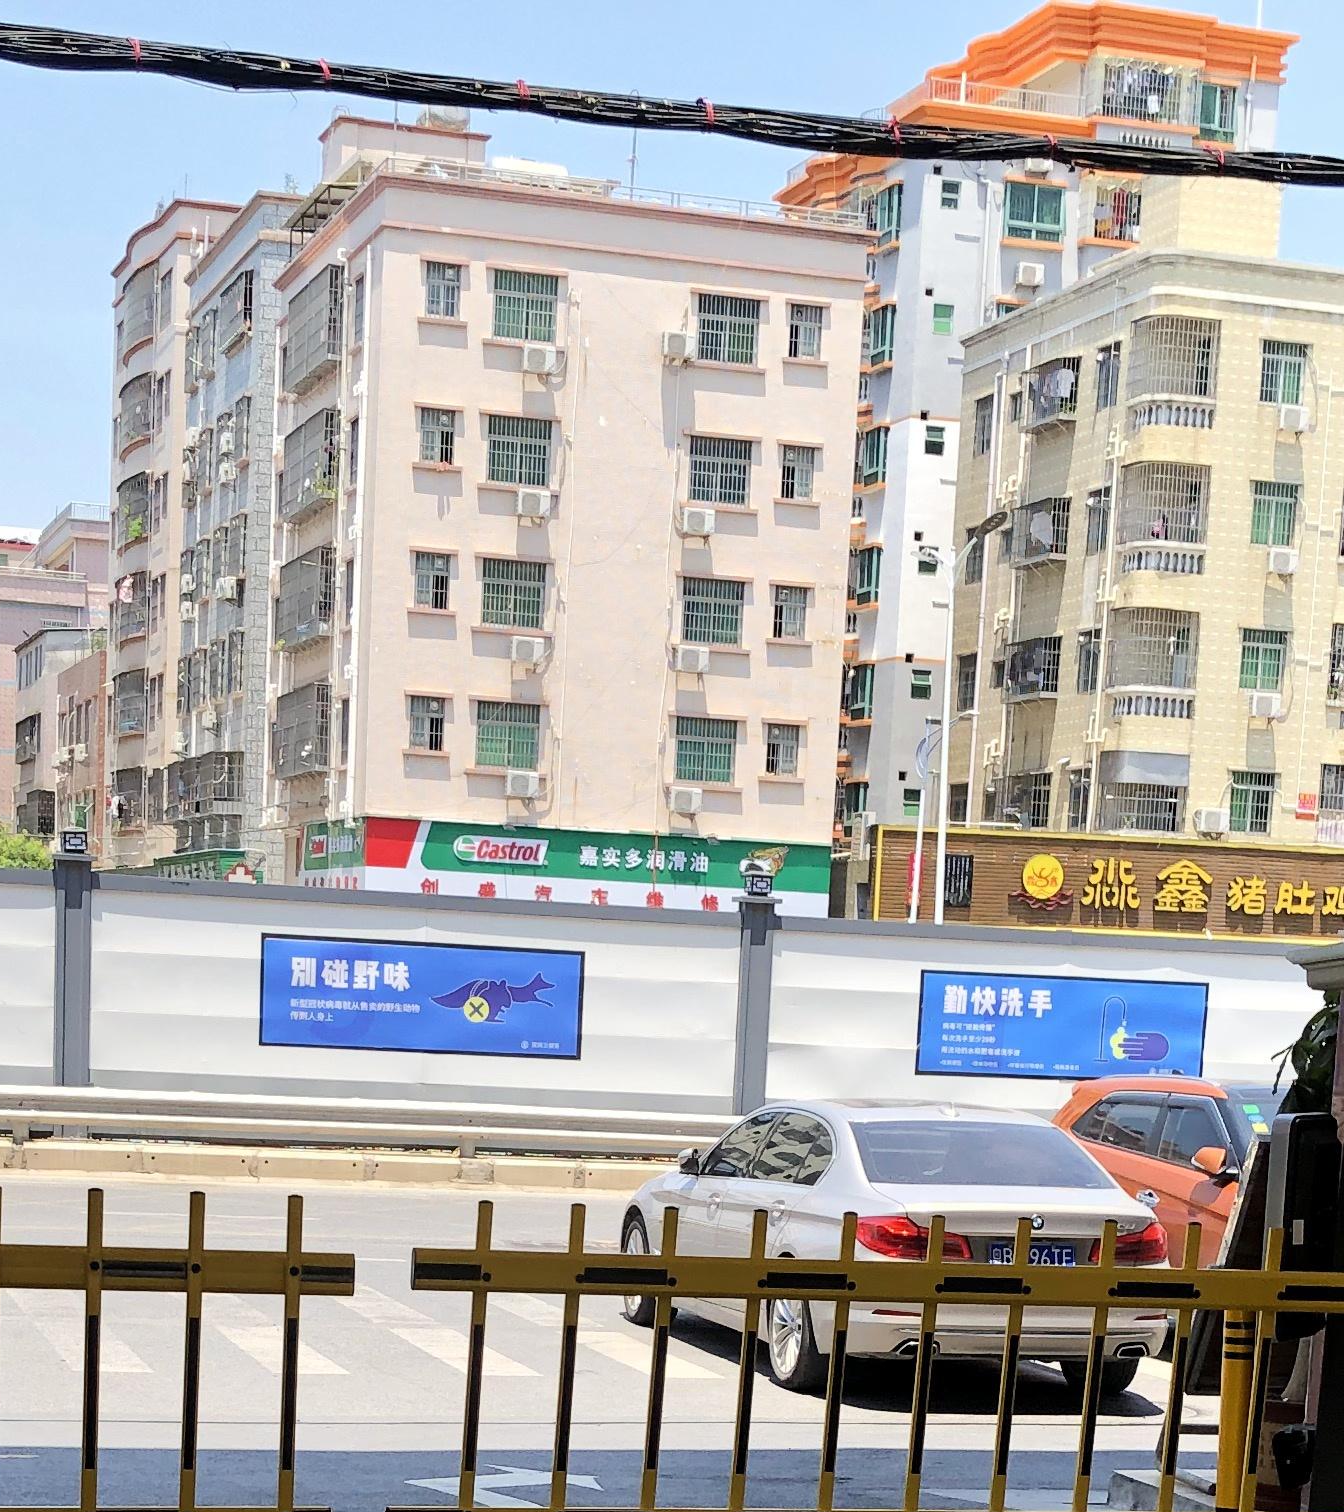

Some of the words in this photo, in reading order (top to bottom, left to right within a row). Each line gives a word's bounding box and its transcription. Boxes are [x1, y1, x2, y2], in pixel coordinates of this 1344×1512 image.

[475, 838, 542, 863] Castrol
[578, 844, 710, 873] 嘉实多润滑油
[420, 876, 720, 912] 创盛汽车维修
[290, 956, 411, 992] 别碰野味
[942, 983, 1053, 1019] 勤快洗手
